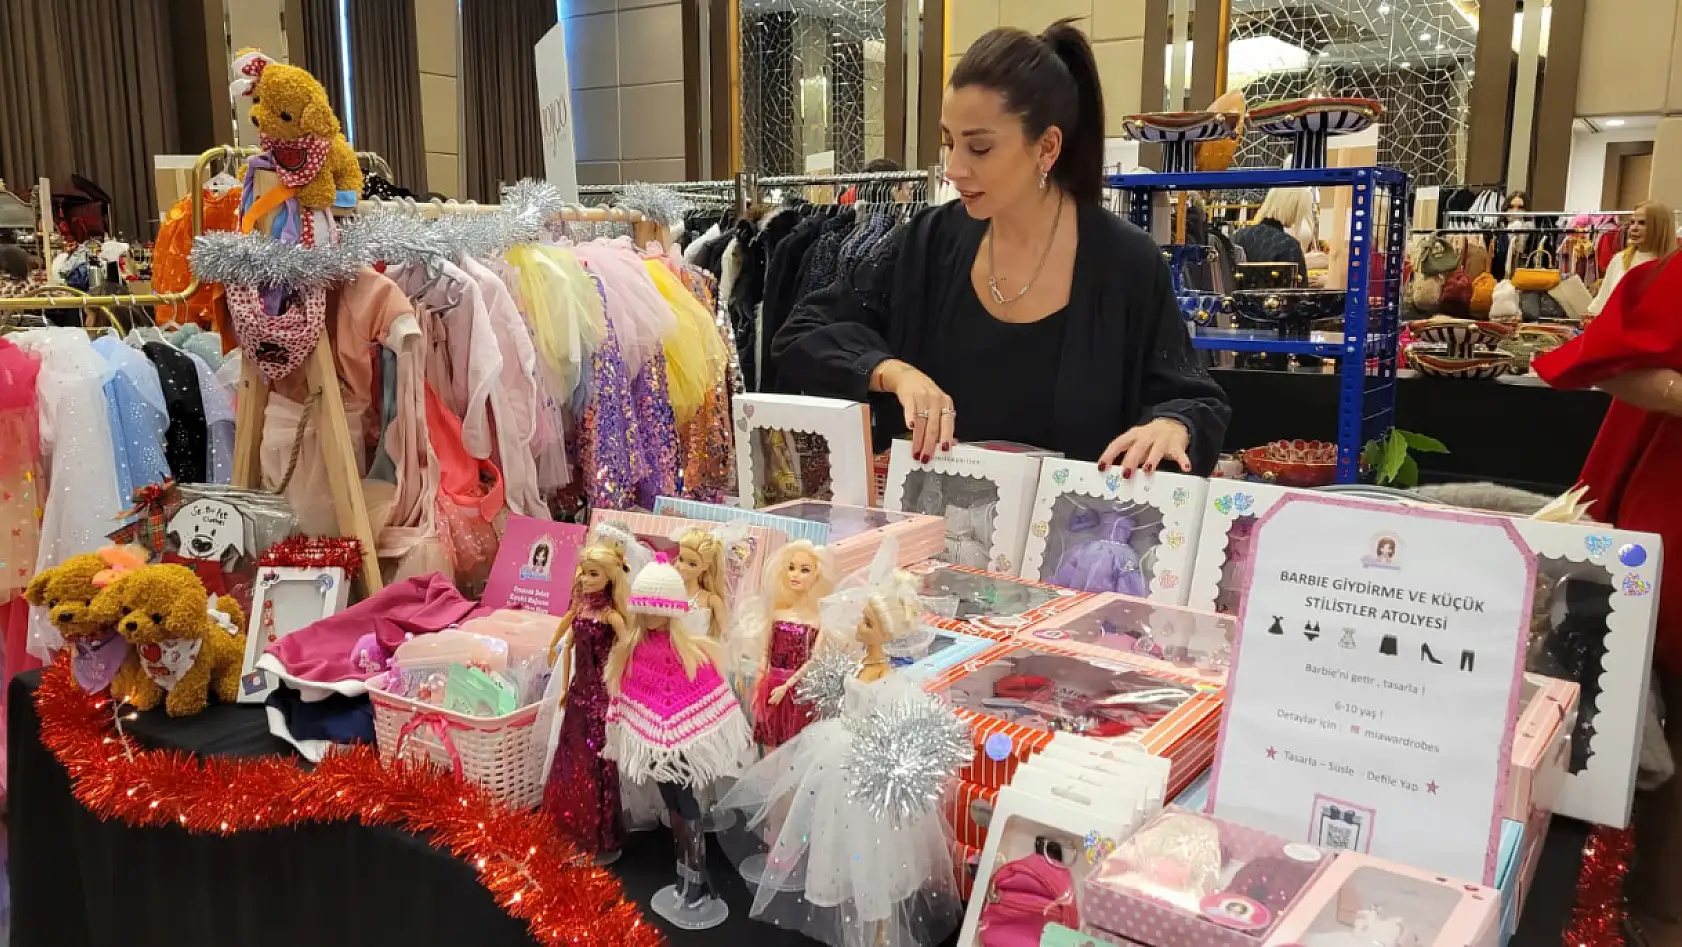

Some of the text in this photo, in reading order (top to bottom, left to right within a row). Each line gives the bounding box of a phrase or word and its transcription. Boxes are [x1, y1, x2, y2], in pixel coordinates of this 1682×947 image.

[1280, 571, 1485, 613] BARBIE GİYDİRME VE KÜÇÜK
[1305, 596, 1448, 630] STİLİSTLER ATOLYESİ
[1351, 674, 1375, 684] getir
[1384, 679, 1418, 694] tasarla
[1335, 701, 1358, 713] 6-10
[1359, 707, 1377, 720] yaş
[1276, 708, 1317, 725] Detaylar
[1319, 718, 1337, 731] için
[1364, 729, 1440, 753] miawardrobes
[1284, 750, 1317, 767] Tasarla
[1328, 761, 1356, 776] Süsle
[1366, 770, 1397, 786] Defile
[1400, 779, 1419, 792] Yap
